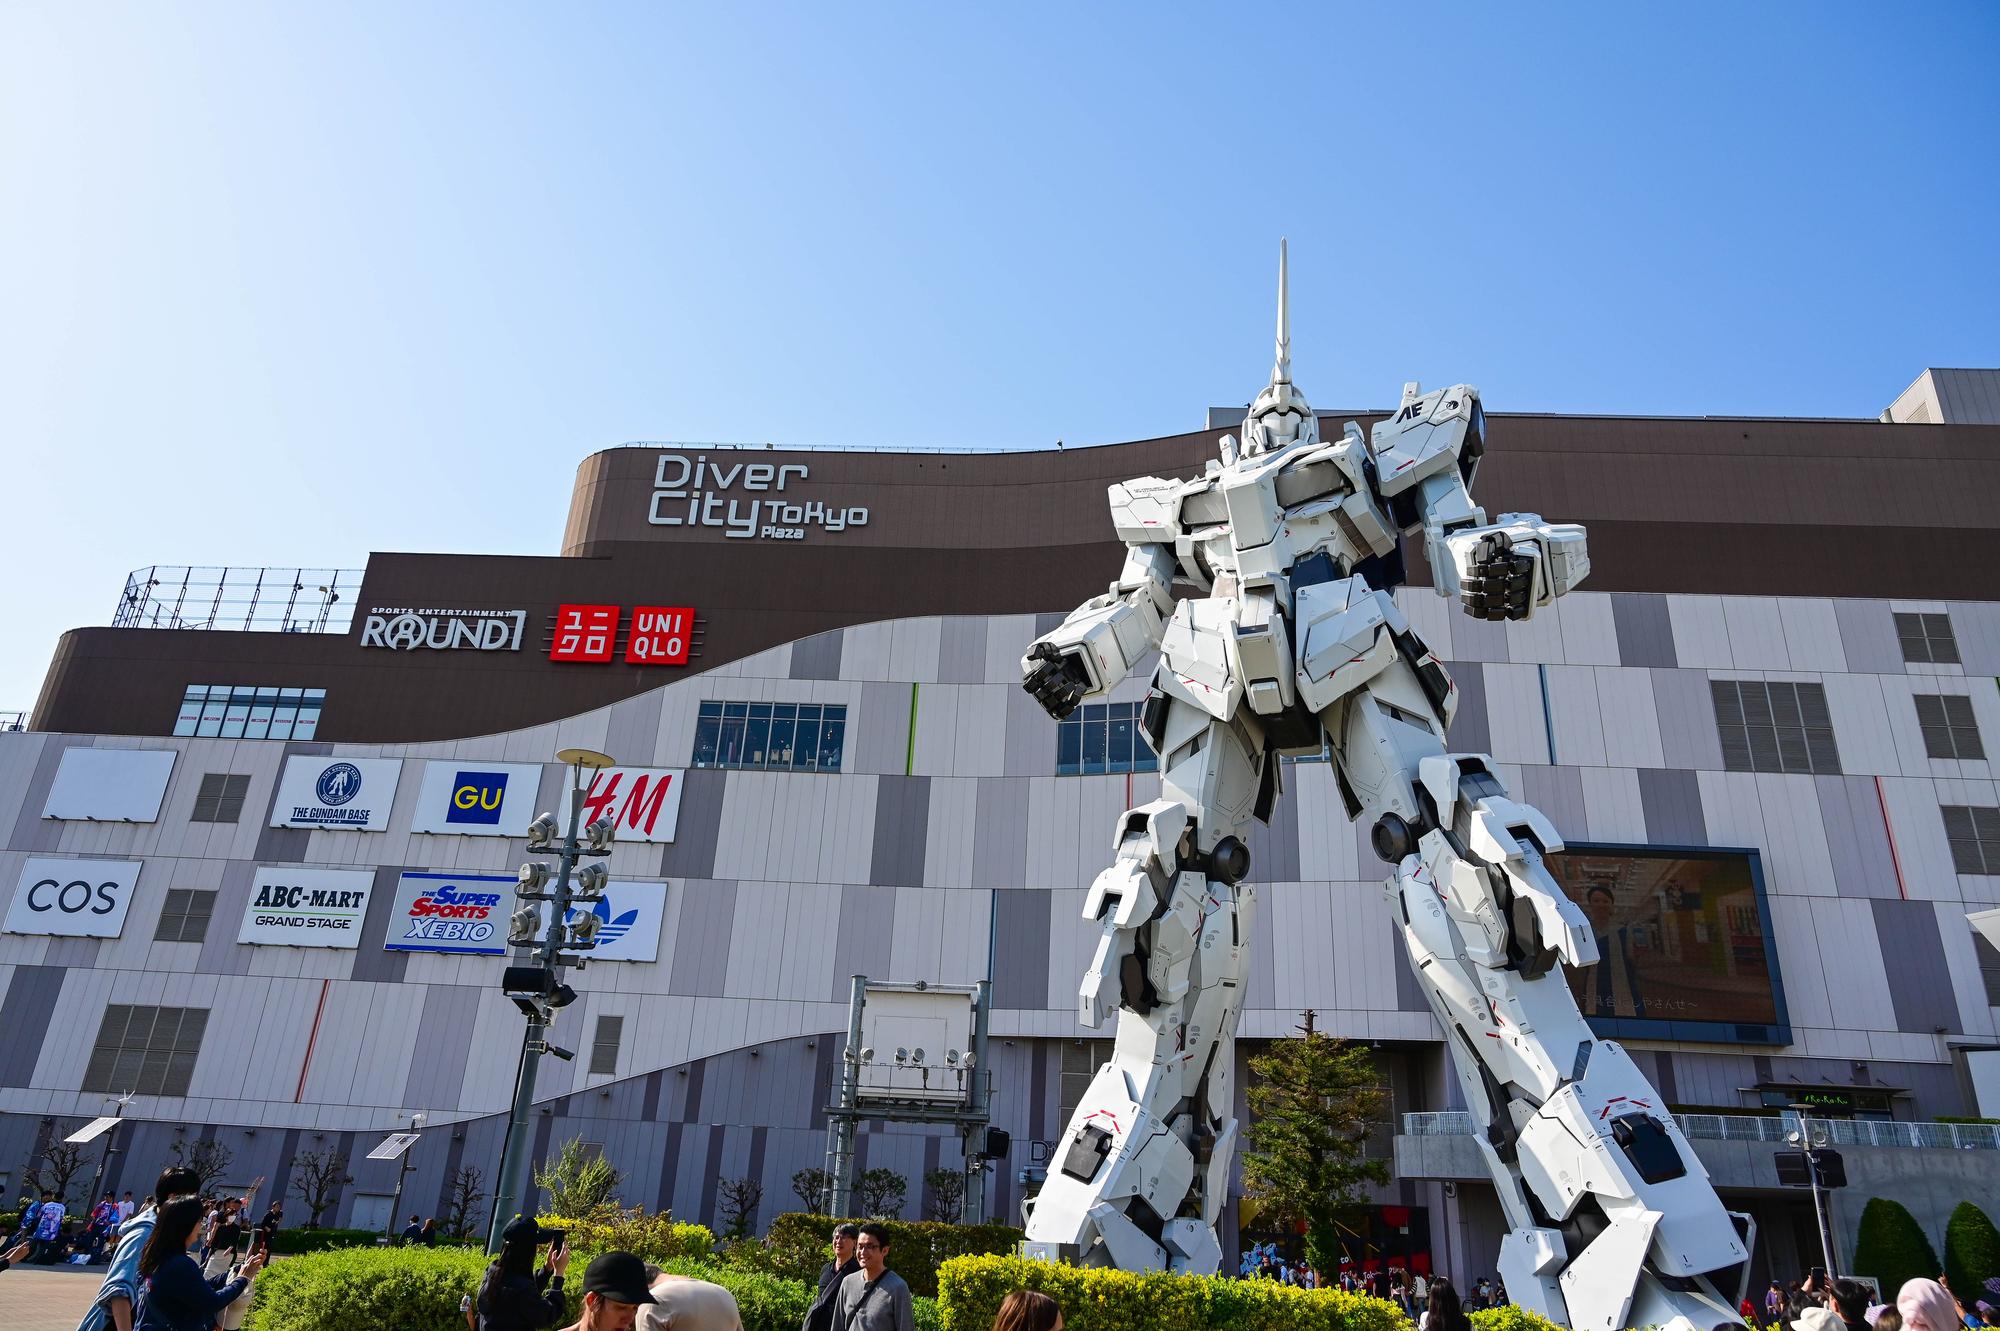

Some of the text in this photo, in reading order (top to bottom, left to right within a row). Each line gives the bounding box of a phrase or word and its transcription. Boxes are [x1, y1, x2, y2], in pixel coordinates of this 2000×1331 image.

[654, 454, 809, 491] Diver
[648, 490, 868, 538] City Tokyo
[760, 525, 804, 539] Plaza
[371, 607, 512, 618] SPORTS ENTERTAINMENT
[638, 613, 682, 633] UNI
[634, 637, 682, 659] QLO
[454, 785, 503, 811] GU
[293, 807, 371, 820] THE GUNDAM BASE
[27, 879, 119, 914] COS
[254, 885, 364, 909] ABC-MART
[432, 885, 501, 906] SUPER
[408, 897, 491, 919] SPORTS
[255, 915, 352, 930] GRAND STAGE
[403, 917, 494, 942] XEBIO
